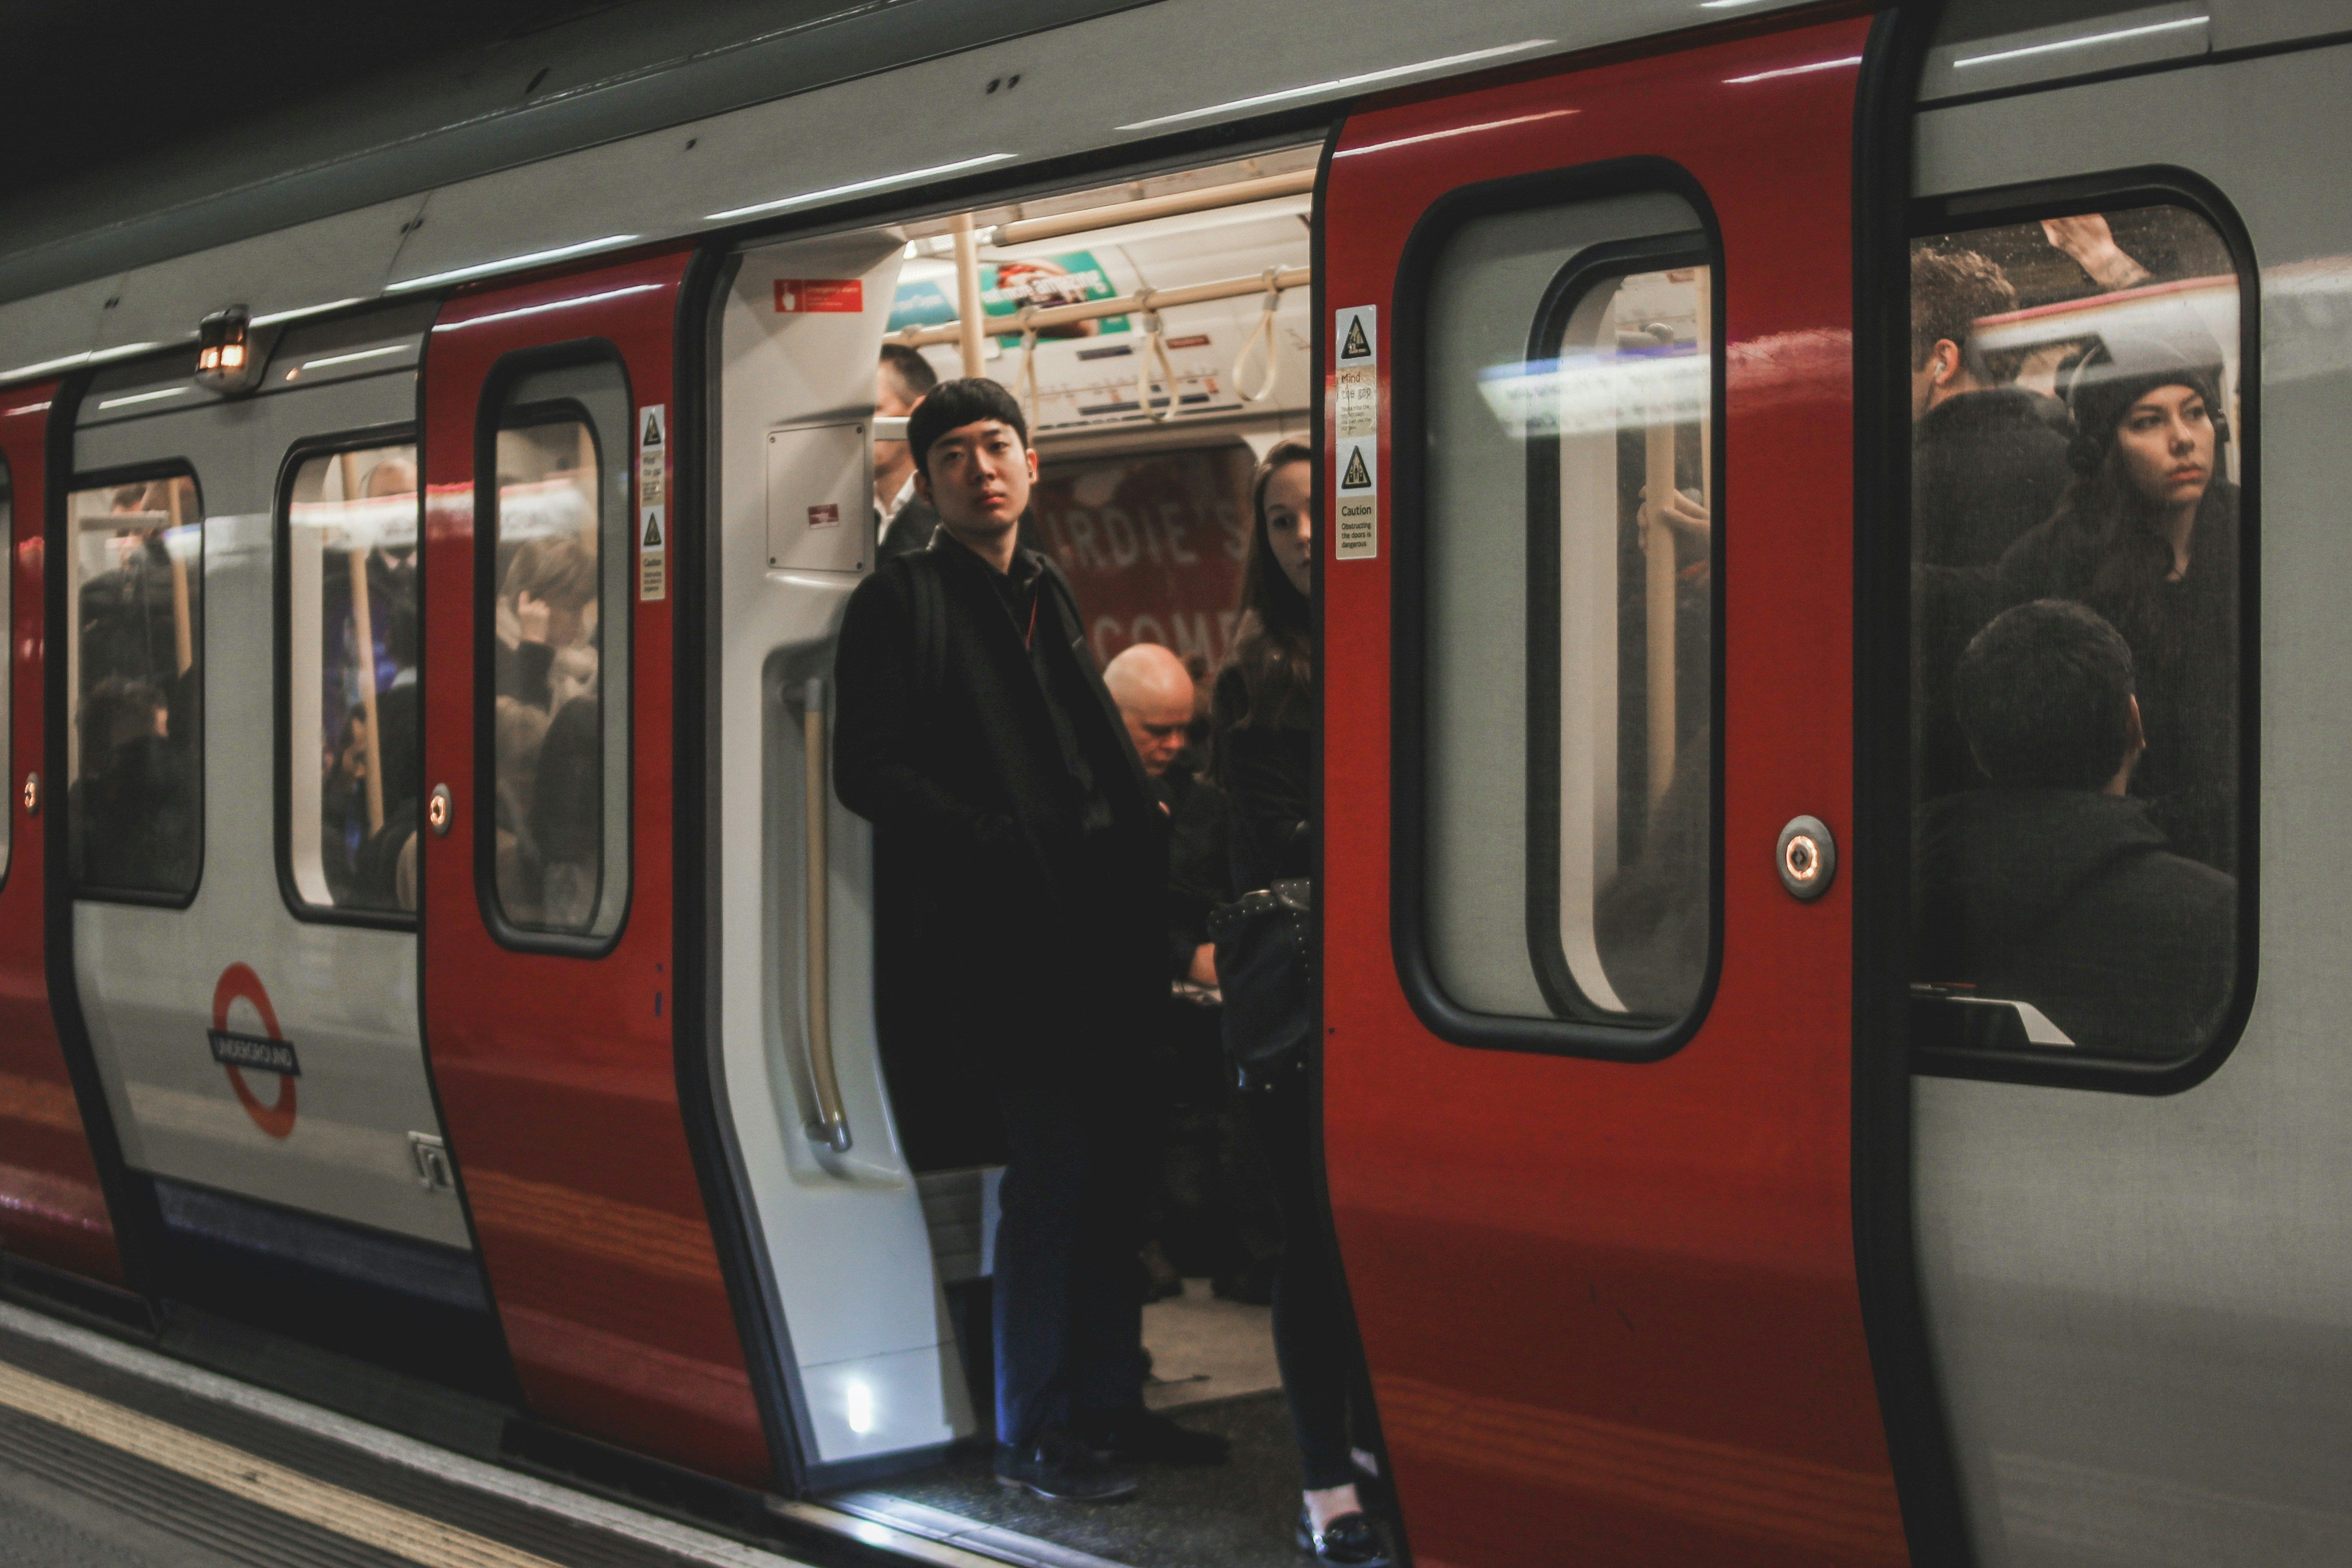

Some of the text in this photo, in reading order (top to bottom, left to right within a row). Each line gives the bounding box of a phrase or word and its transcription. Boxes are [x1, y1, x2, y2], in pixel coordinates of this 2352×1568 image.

[1341, 372, 1360, 383] Mind
[1342, 388, 1371, 399] the gap
[1341, 505, 1371, 516] Caution
[1047, 502, 1243, 569] IRDIE'S
[1341, 541, 1366, 549] dangerous
[215, 1036, 293, 1068] UNDERGROUND
